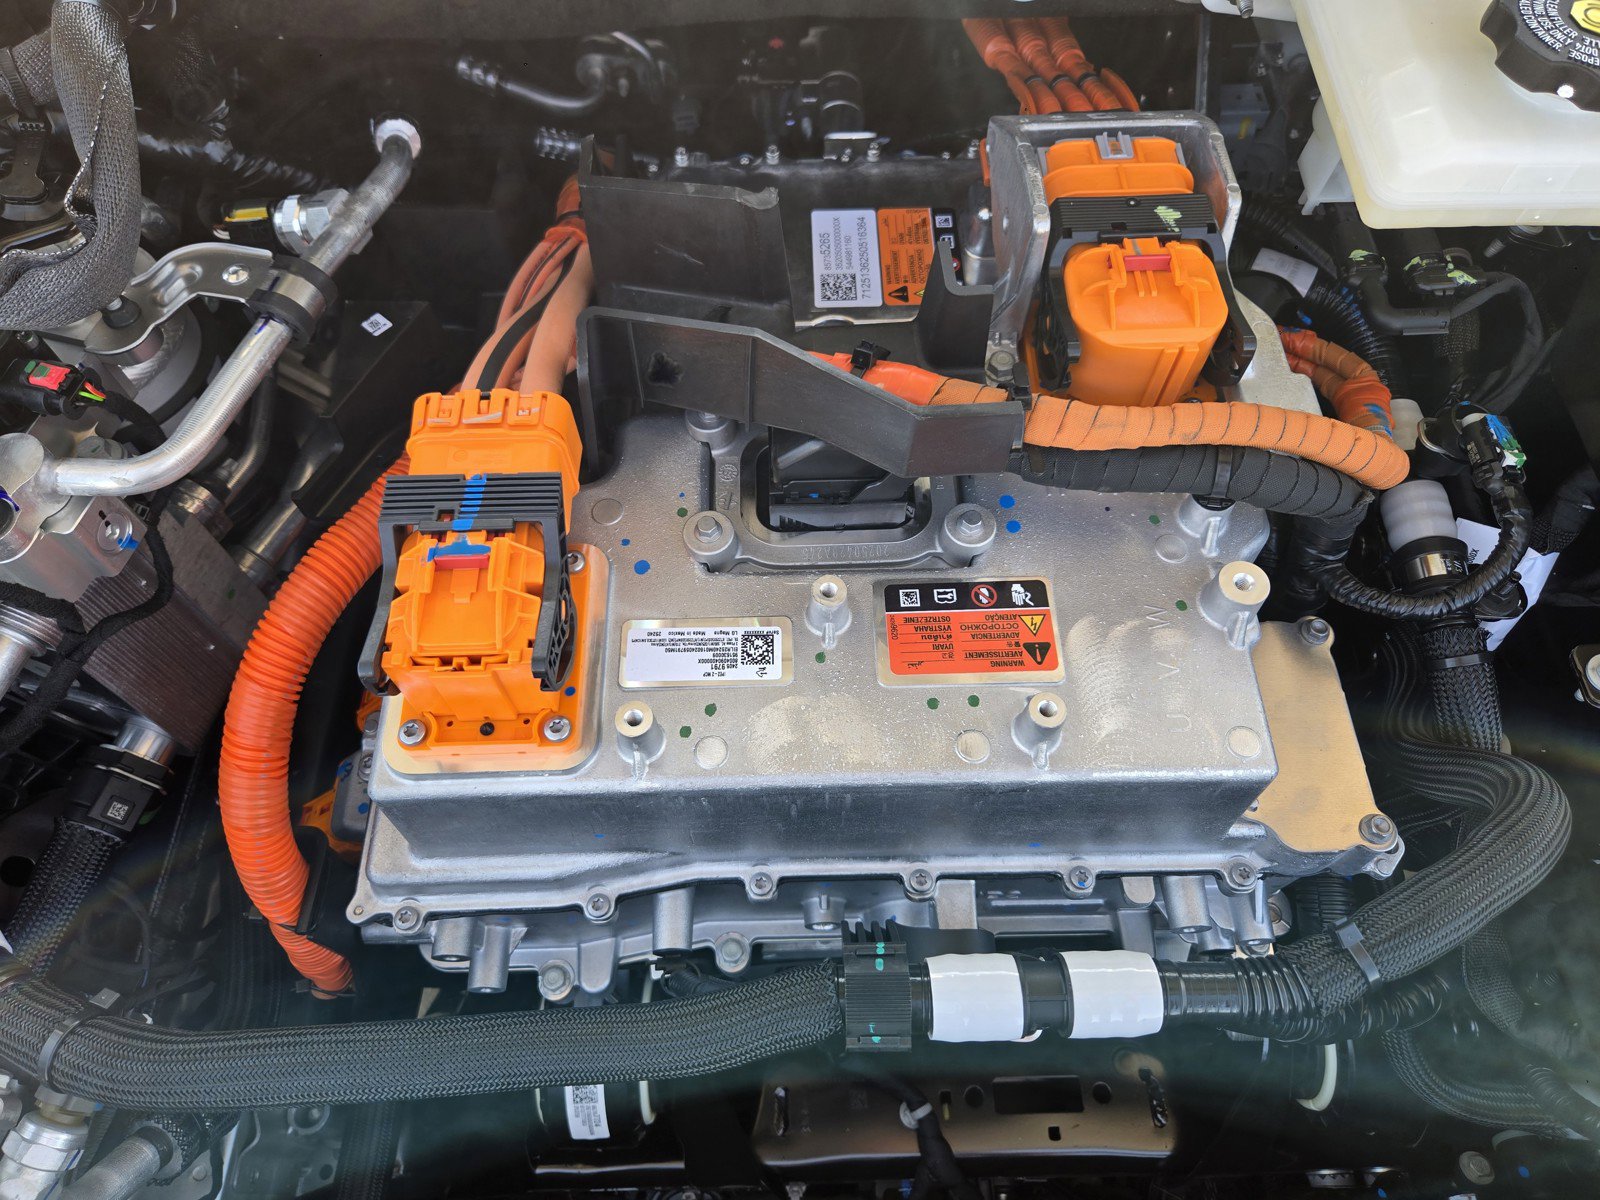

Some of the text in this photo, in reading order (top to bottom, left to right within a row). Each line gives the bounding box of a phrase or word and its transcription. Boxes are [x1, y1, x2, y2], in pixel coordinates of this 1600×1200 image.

[1524, 15, 1562, 52] CONTAINER.
[1538, 18, 1555, 30] USE
[1550, 29, 1574, 46] ONLY
[1550, 16, 1578, 38] FILLER
[1576, 42, 1598, 57] DOT4
[984, 614, 1017, 622] ATENÇÃO
[914, 624, 952, 632] VÝSTRAHA
[964, 651, 1023, 659] AVERTISSEMENT
